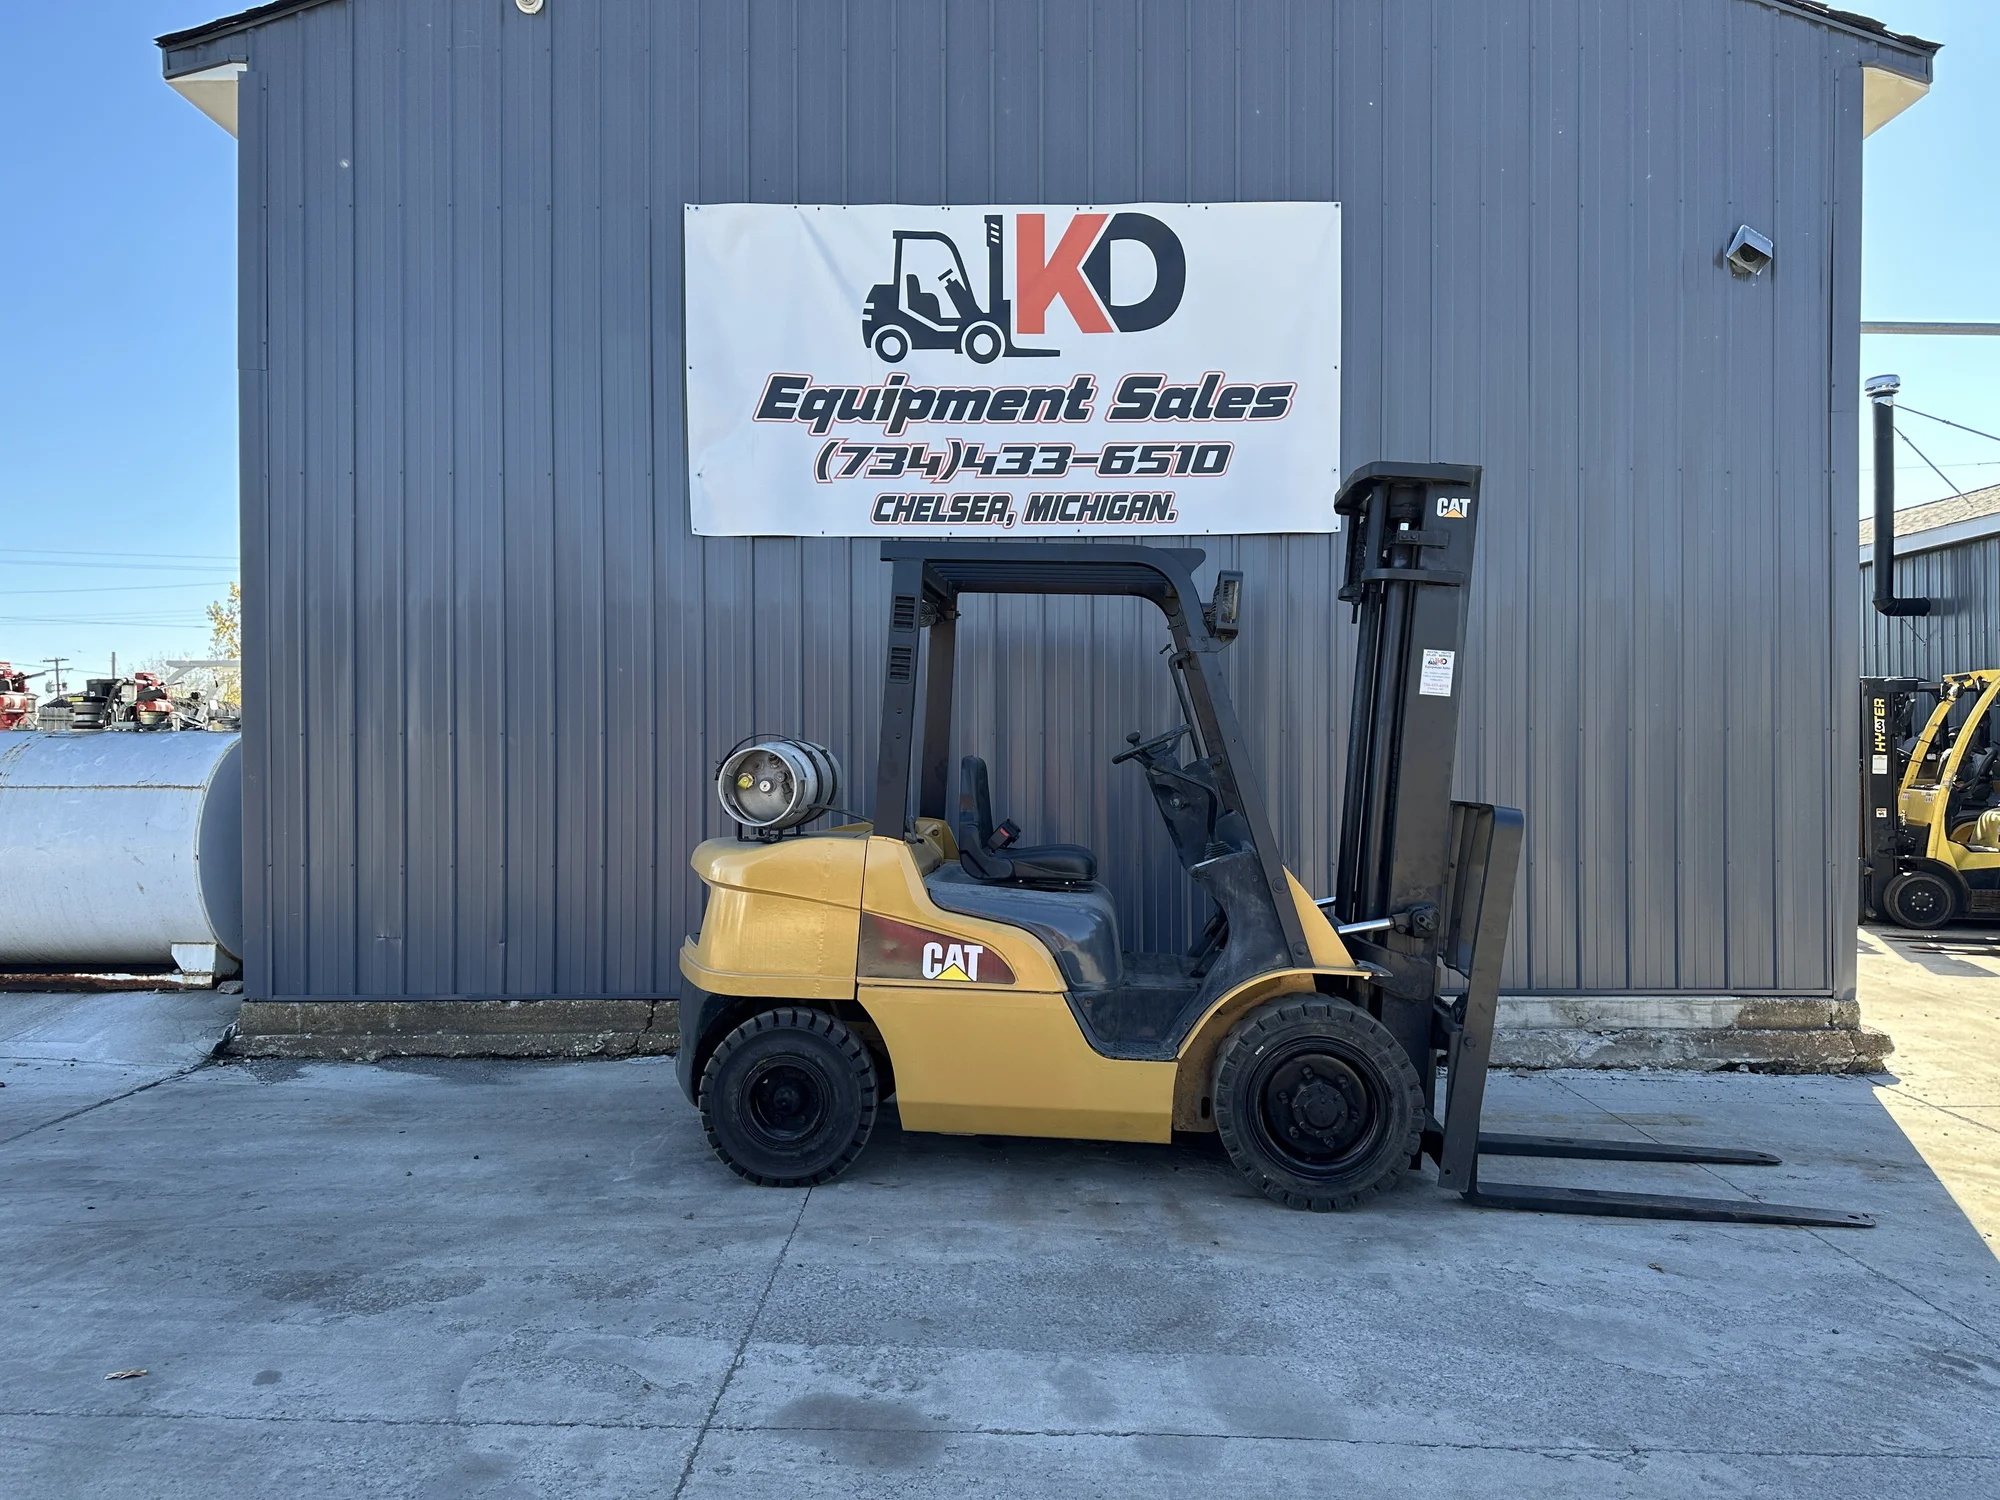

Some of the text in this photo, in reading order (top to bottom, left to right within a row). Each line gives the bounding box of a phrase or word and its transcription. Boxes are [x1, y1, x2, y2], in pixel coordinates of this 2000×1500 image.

[1015, 211, 1187, 335] KD
[753, 371, 1298, 436] Equipment Sales
[814, 438, 1235, 484] (734)433-6510
[870, 491, 1179, 529] CHELSEA, MICHIGAN.
[1436, 497, 1471, 518] CAT
[1874, 698, 1885, 751] HYTER
[922, 941, 983, 982] CAT
